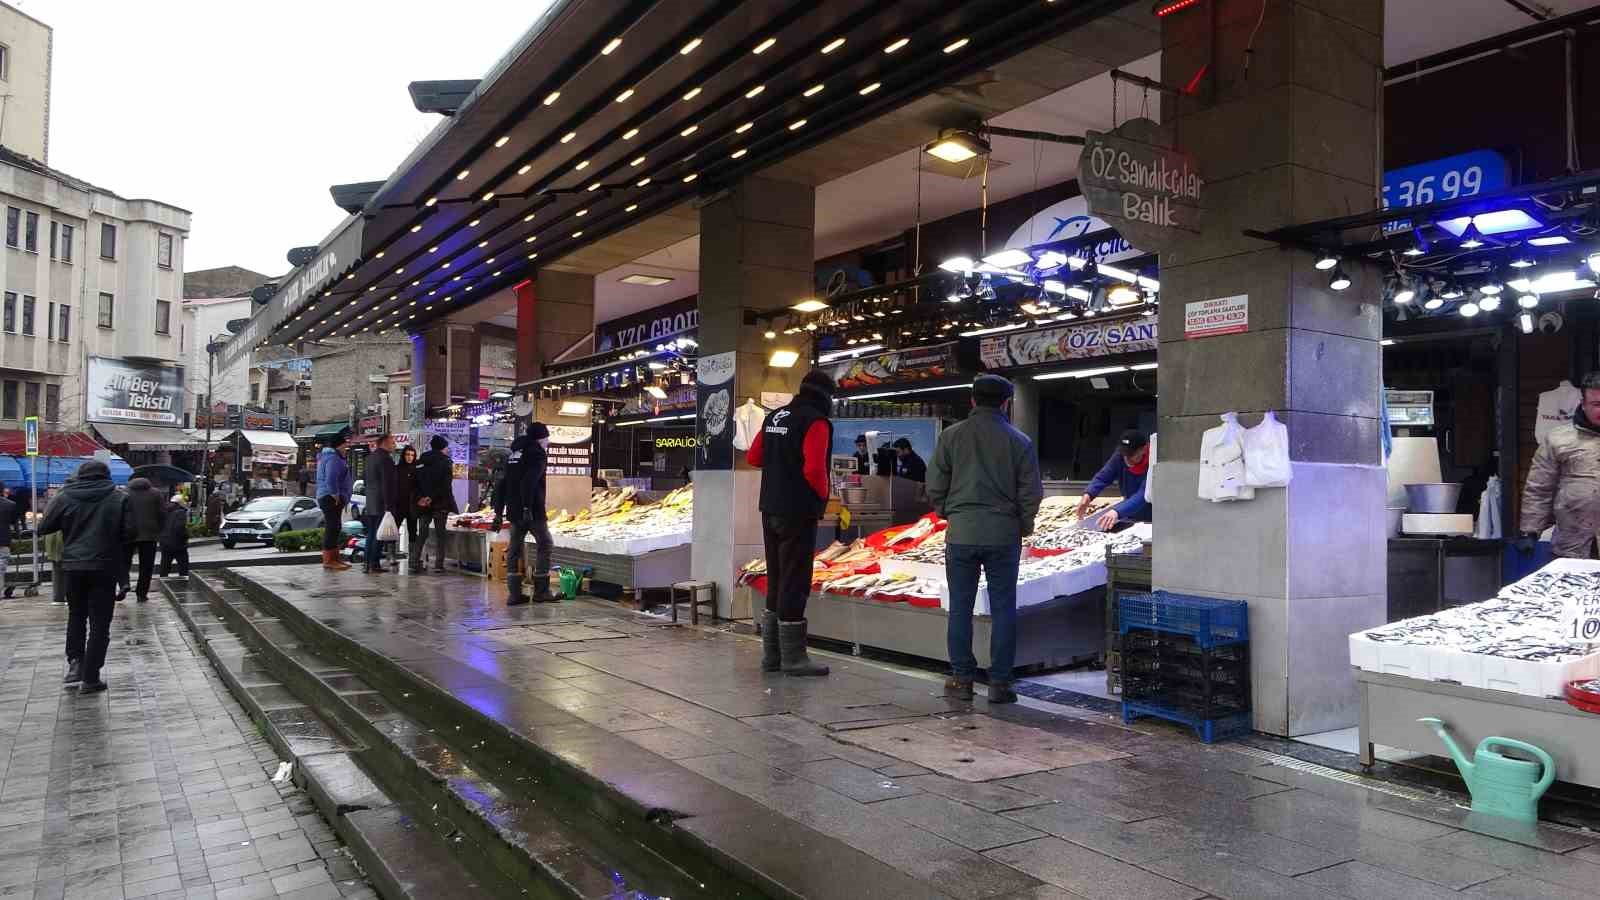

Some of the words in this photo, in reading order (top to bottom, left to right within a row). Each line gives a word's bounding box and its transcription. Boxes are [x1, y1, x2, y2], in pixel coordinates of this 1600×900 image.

[1118, 151, 1205, 200] Sandıkçılar
[1439, 165, 1483, 201] 99
[1121, 192, 1180, 227] Balık
[1069, 329, 1100, 348] ÖZ
[1106, 322, 1156, 345] SAN
[130, 377, 159, 395] Bey
[128, 392, 172, 411] Tekstil
